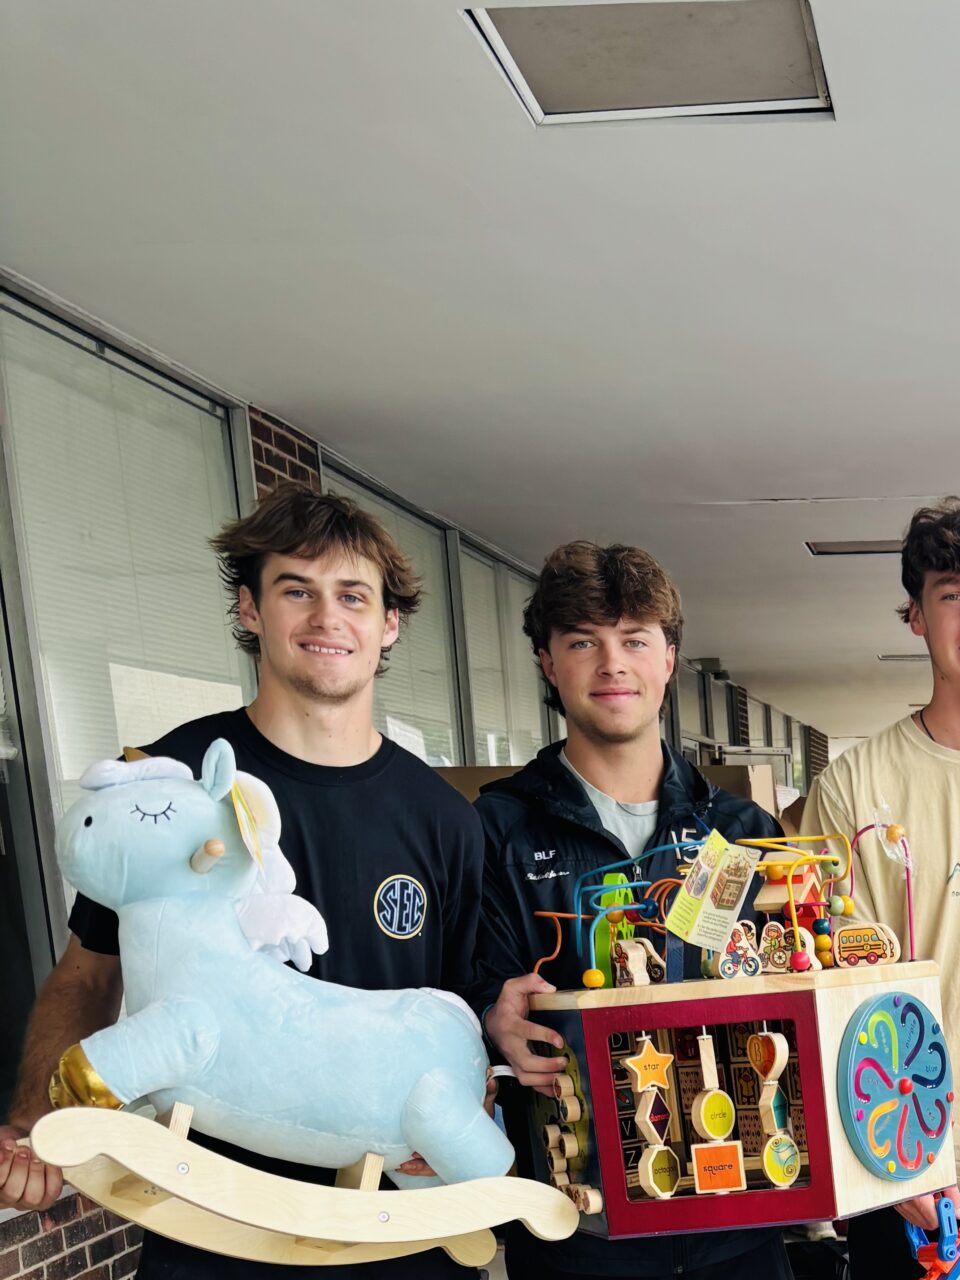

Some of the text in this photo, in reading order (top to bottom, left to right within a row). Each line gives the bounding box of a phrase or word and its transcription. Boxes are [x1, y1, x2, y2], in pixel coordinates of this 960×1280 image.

[534, 849, 556, 861] BLF
[379, 879, 424, 934] SEC
[643, 1062, 660, 1071] star
[709, 1110, 728, 1121] circle
[703, 1163, 733, 1176] square
